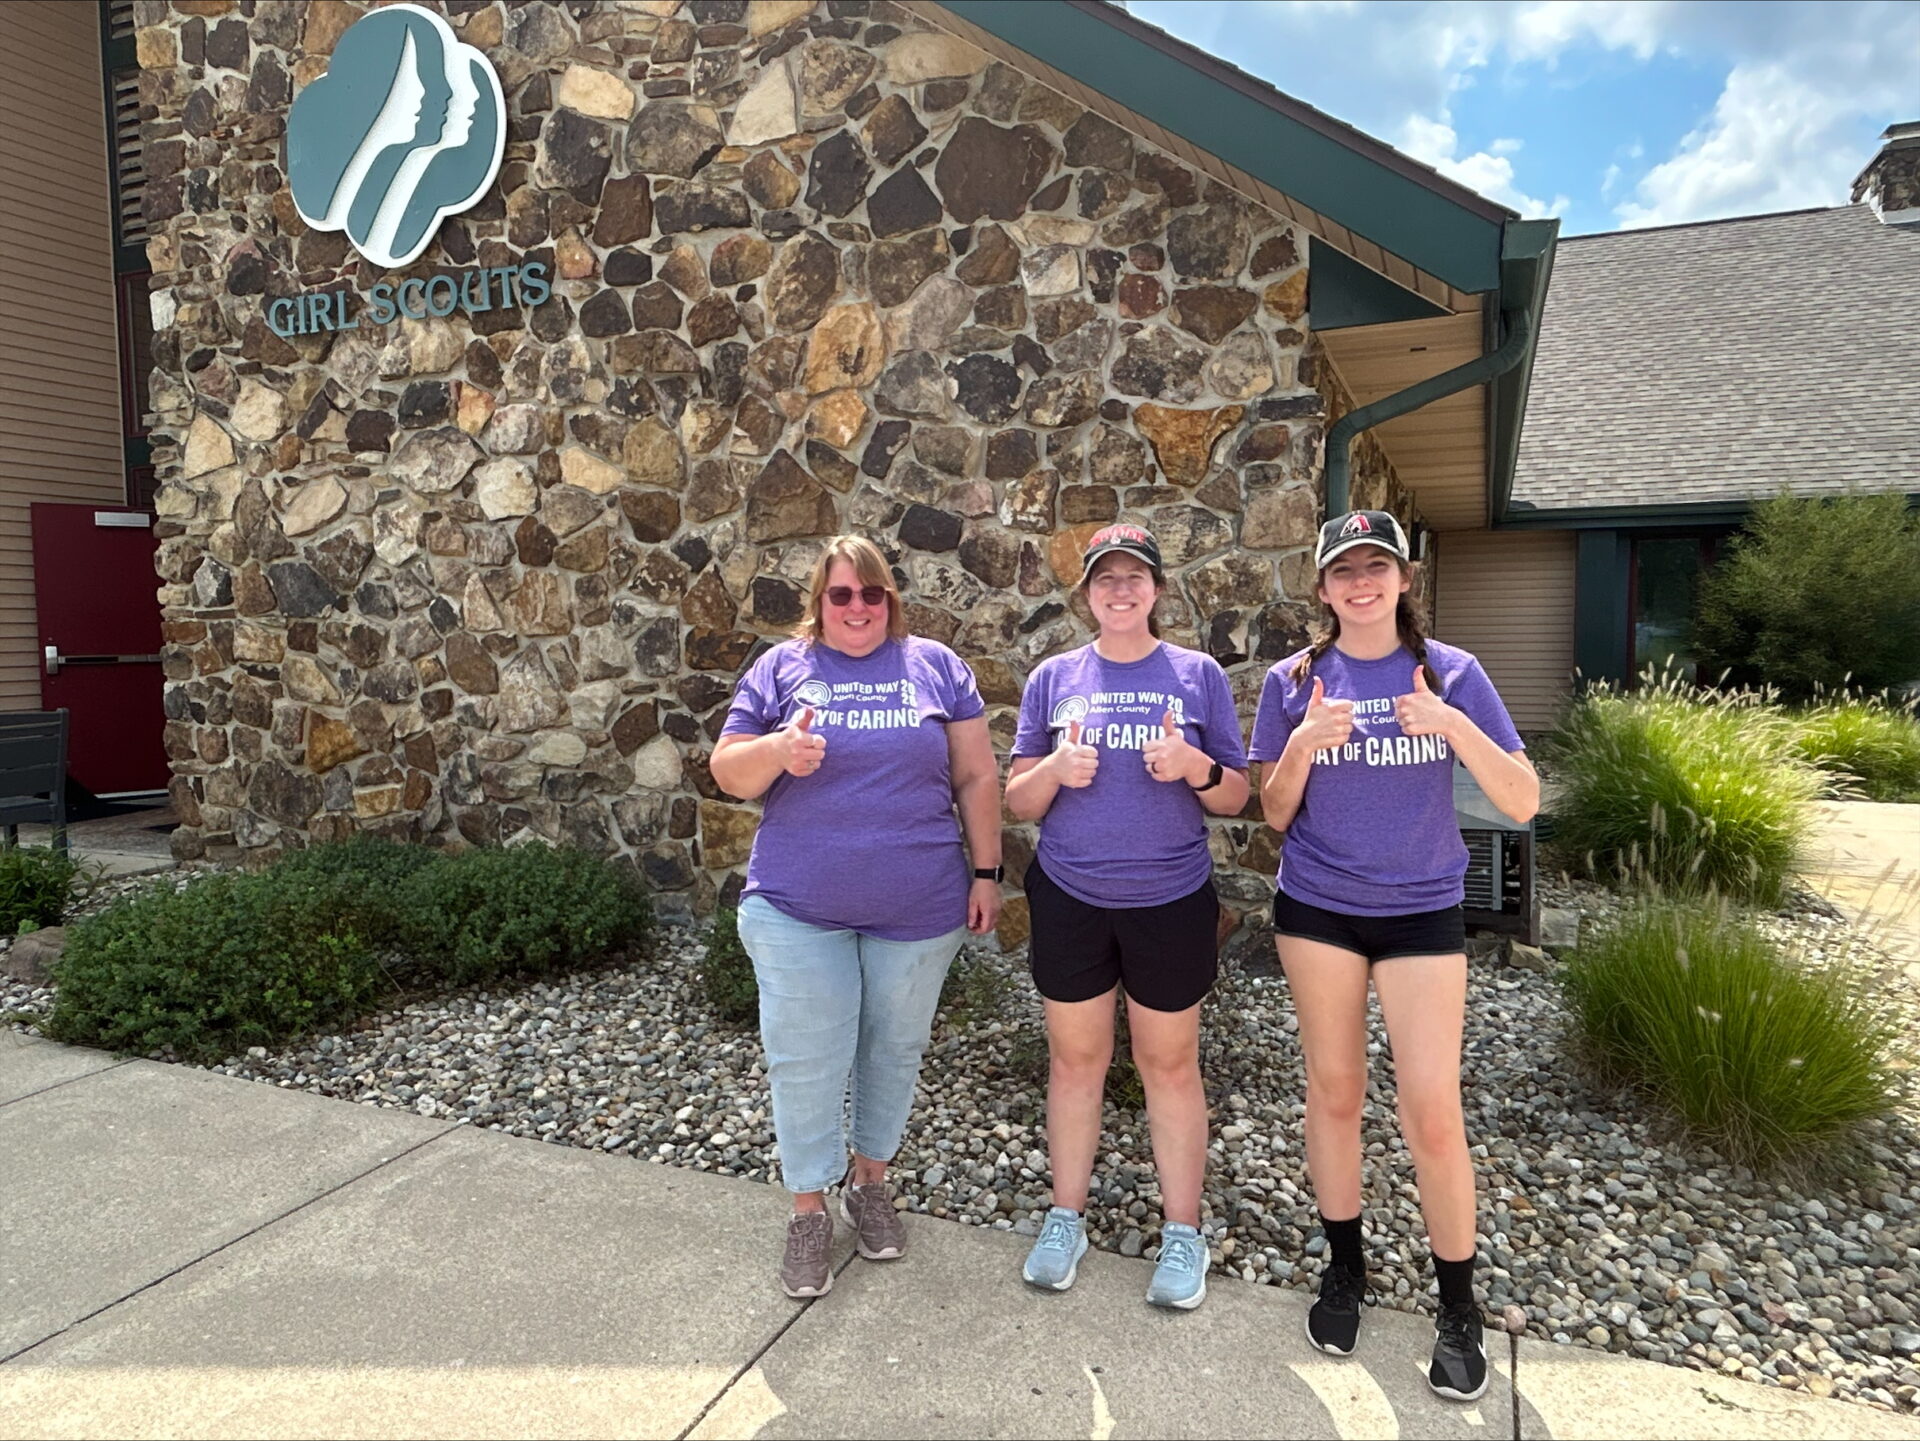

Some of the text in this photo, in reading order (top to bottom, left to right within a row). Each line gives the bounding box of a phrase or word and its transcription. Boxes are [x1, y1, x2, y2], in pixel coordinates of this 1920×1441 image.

[268, 262, 551, 337] GIRL SCOUTS
[833, 682, 873, 694] UNITED
[875, 681, 899, 693] WAY
[833, 693, 855, 701] Allen
[856, 694, 888, 703] County
[1091, 692, 1135, 704] UNITED
[1138, 692, 1164, 704] WAY
[1352, 698, 1390, 714] NITED
[1090, 705, 1114, 713] Allen
[1116, 705, 1151, 714] County
[829, 710, 844, 725] OF
[847, 708, 920, 729] CARING
[1086, 728, 1103, 744] OF
[1344, 743, 1361, 761] OF
[1366, 734, 1447, 766] CARING
